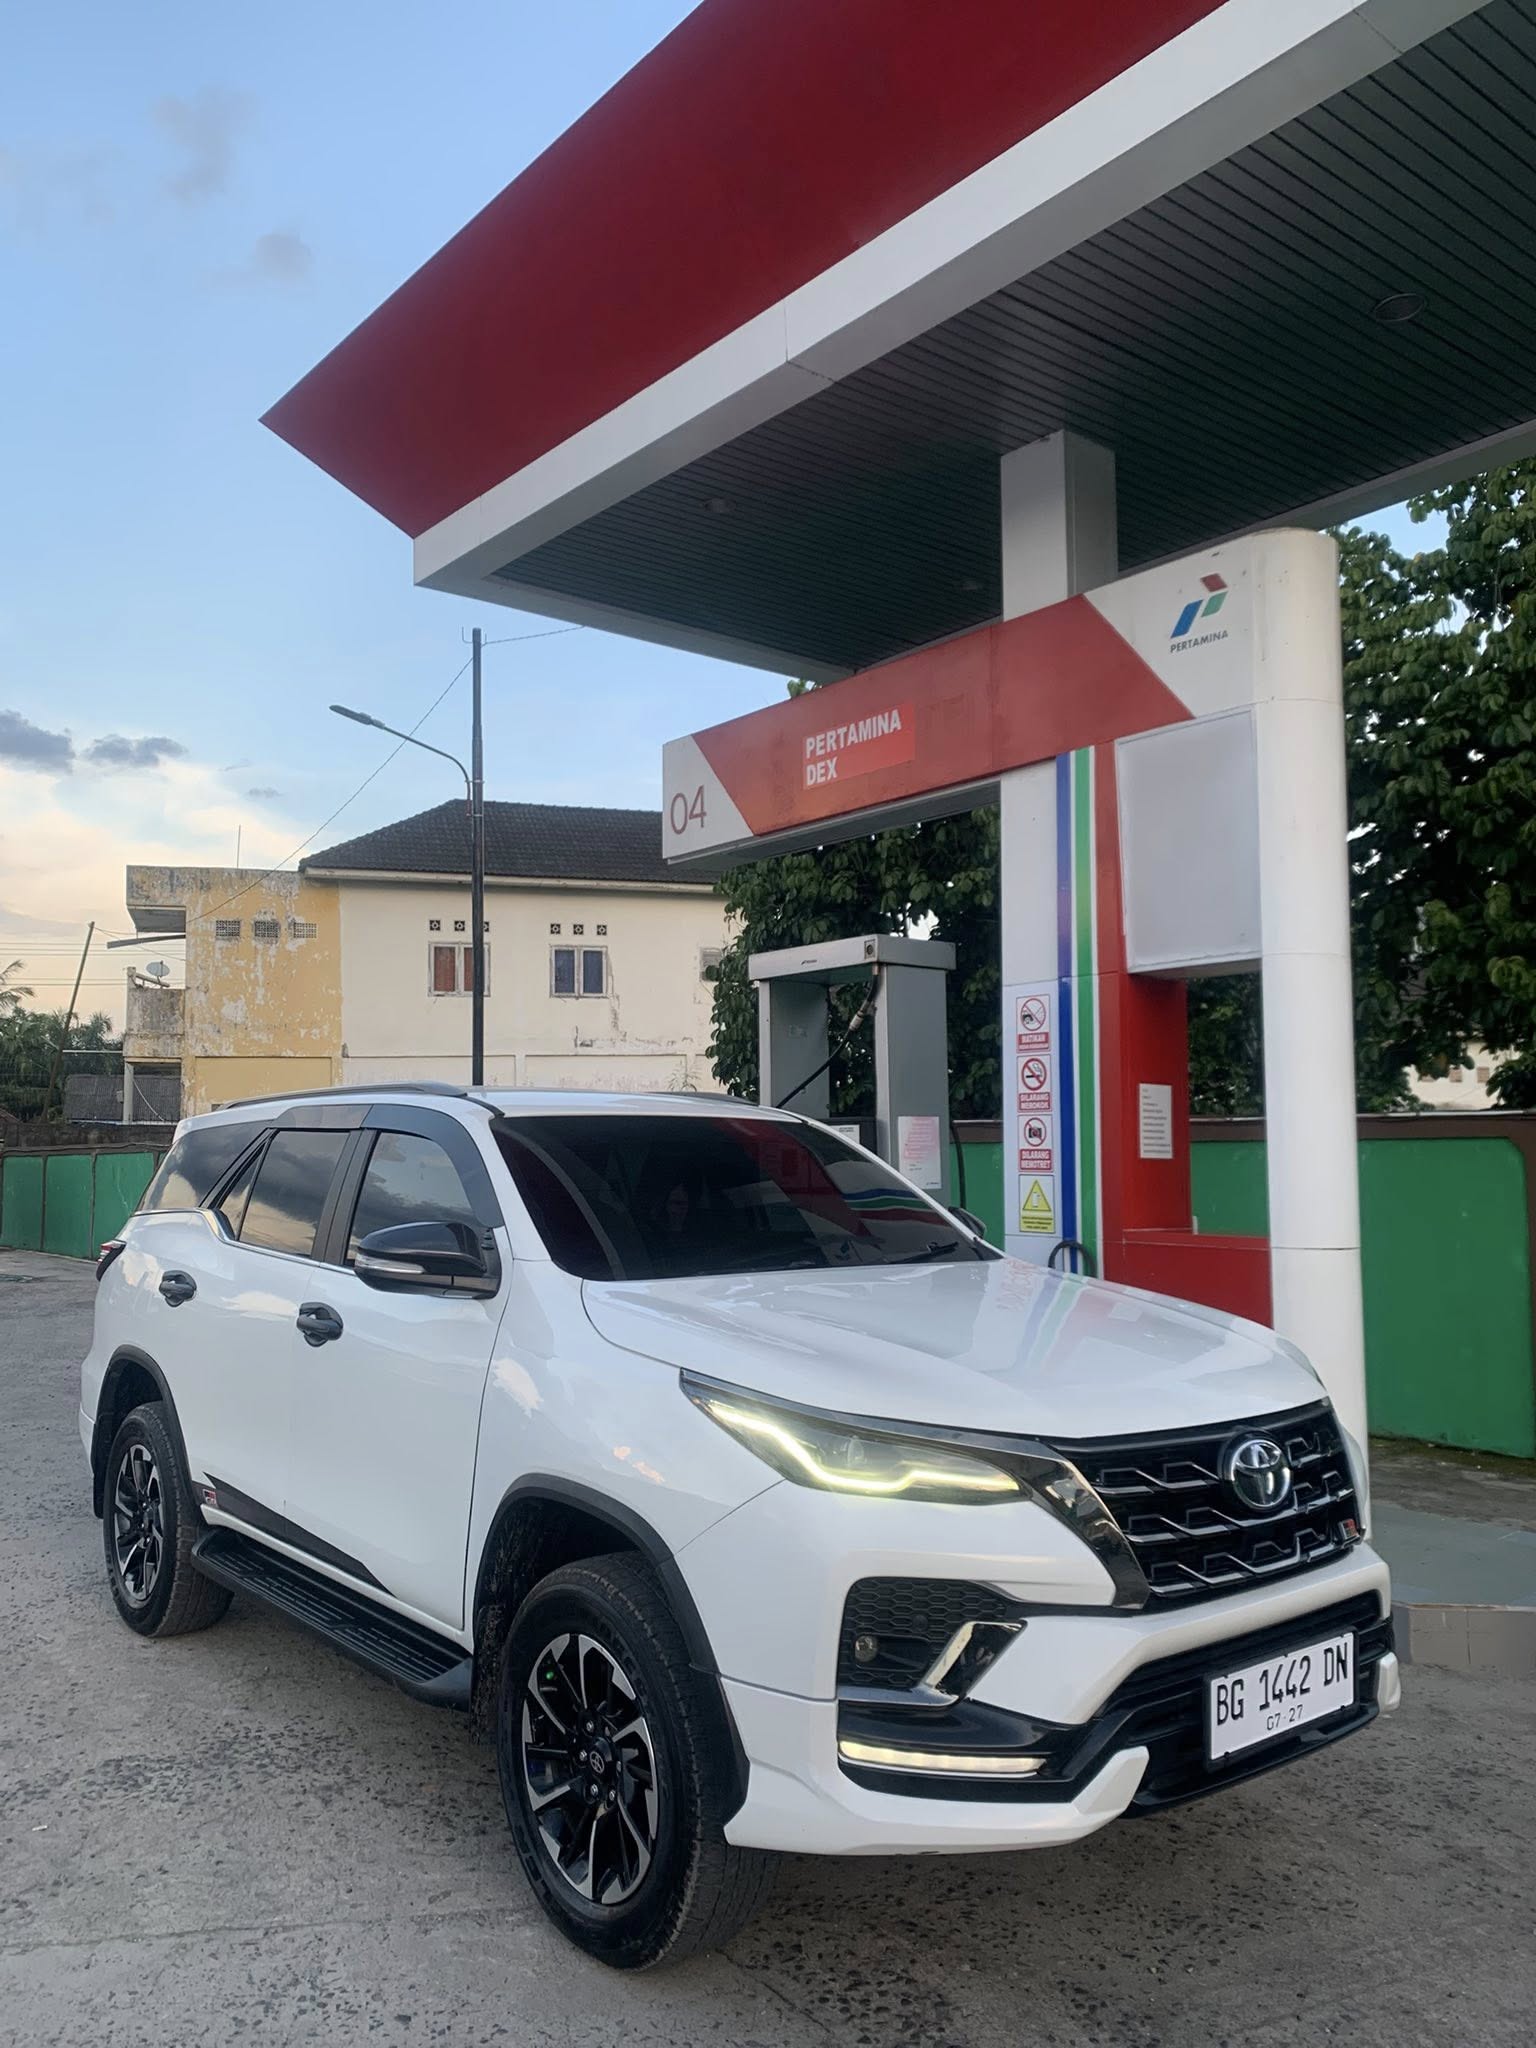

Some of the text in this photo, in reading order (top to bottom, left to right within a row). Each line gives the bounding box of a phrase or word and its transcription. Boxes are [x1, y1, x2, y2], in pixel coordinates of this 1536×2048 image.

[1170, 630, 1229, 653] PERTAMINA
[805, 709, 902, 759] PERTAMINA
[806, 757, 838, 786] DEX
[670, 785, 707, 835] 04
[1217, 1642, 1348, 1726] BG 1442 DN
